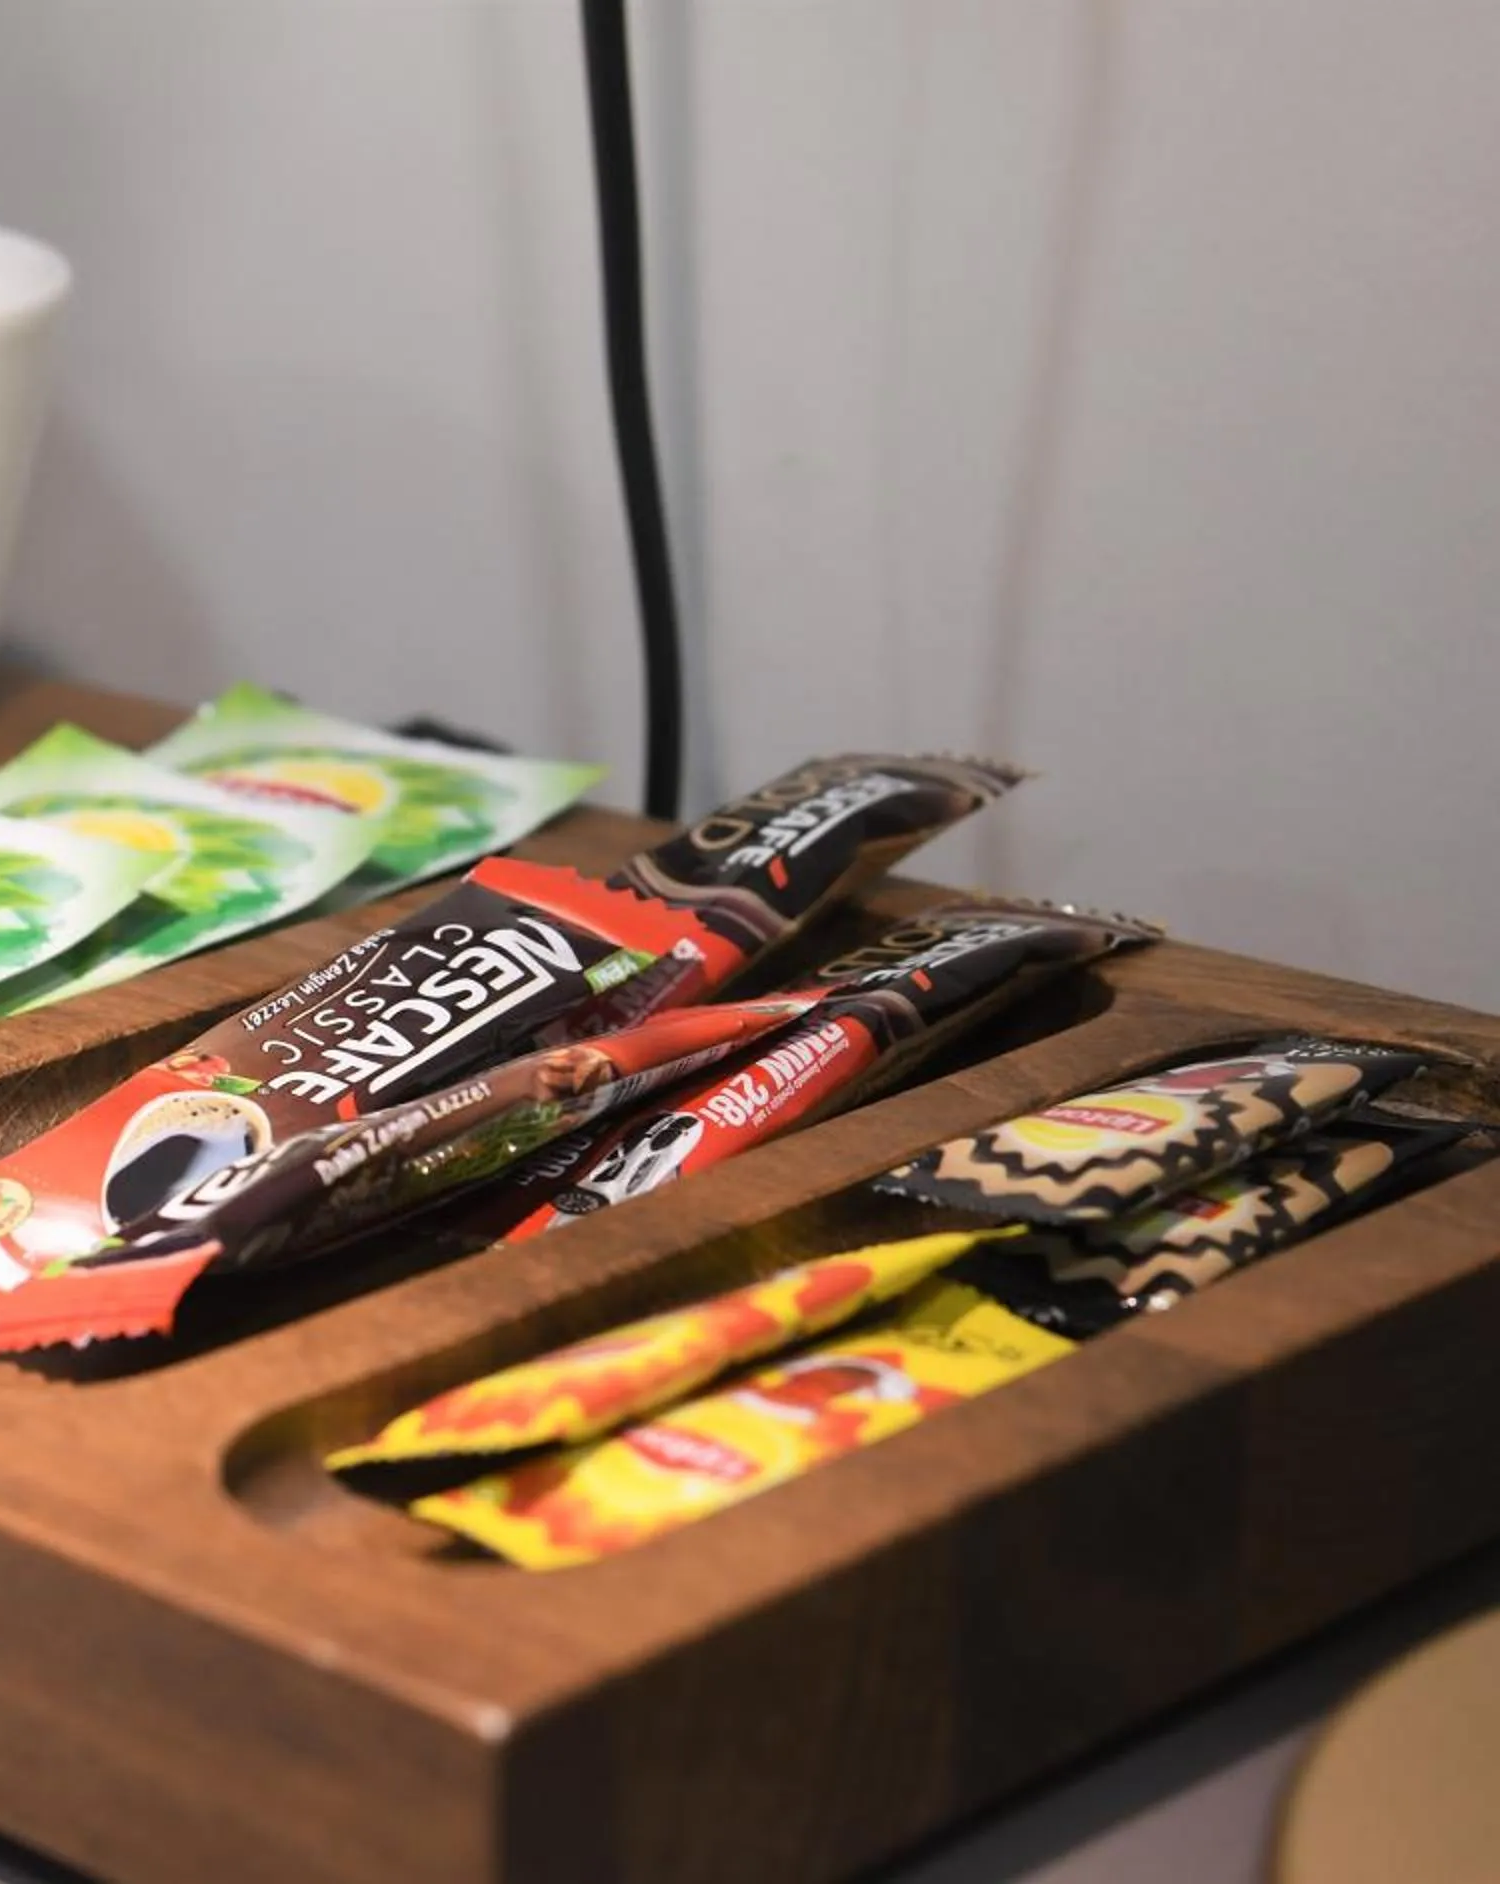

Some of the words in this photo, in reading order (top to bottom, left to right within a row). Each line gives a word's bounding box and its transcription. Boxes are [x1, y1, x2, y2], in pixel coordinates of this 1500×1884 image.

[261, 923, 474, 1065] CLASSIC
[298, 953, 359, 996] Zengin
[240, 990, 306, 1033] Lezzet
[422, 1080, 492, 1120] Lezzet
[697, 1072, 770, 1129] 218i
